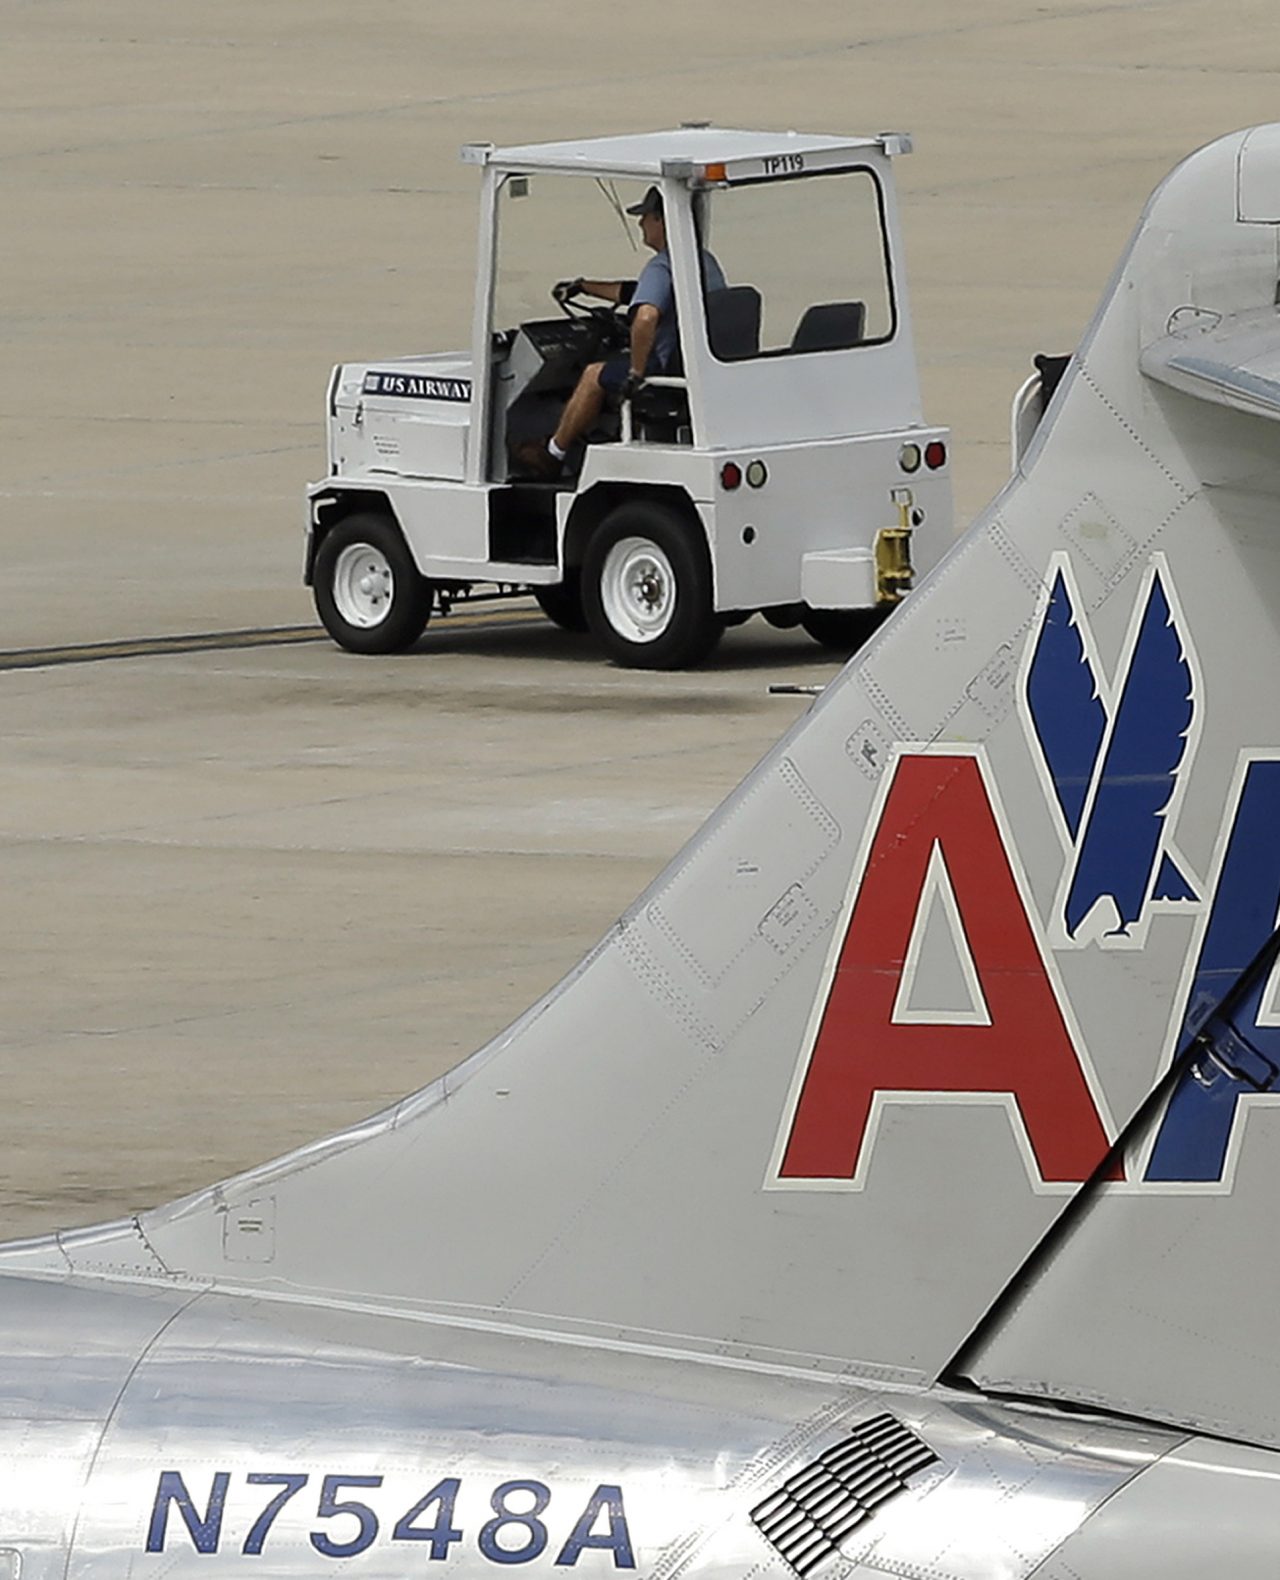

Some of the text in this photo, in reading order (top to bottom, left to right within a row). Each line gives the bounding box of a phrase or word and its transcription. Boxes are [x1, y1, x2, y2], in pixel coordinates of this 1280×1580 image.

[762, 154, 804, 174] TP119
[382, 376, 405, 393] US
[144, 1471, 637, 1570] N7548A
